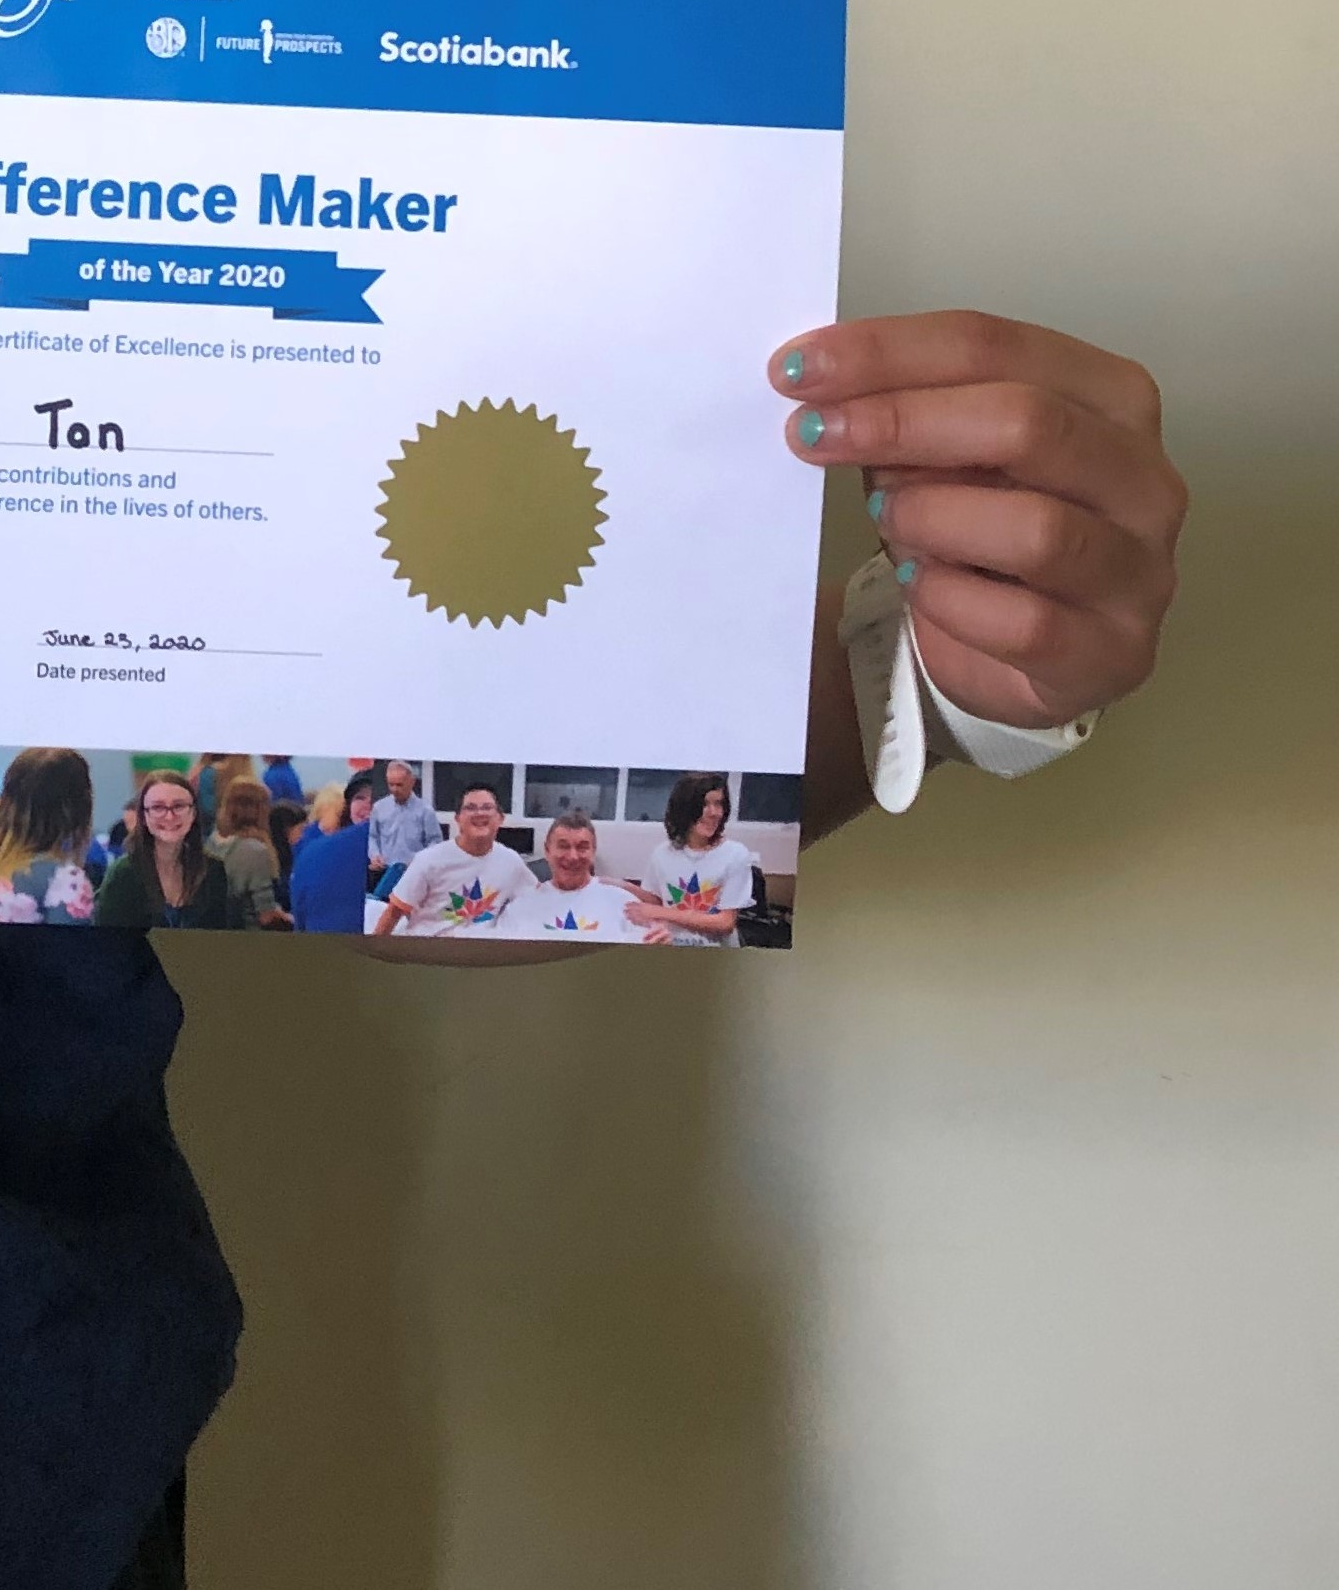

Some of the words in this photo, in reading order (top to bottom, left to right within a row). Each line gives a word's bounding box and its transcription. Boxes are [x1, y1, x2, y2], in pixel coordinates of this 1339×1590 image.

[216, 37, 260, 50] FUTURE
[380, 32, 569, 70] Scotiabank
[259, 172, 457, 234] Maker
[79, 259, 105, 281] of
[111, 262, 151, 283] the
[158, 261, 213, 286] Year
[220, 265, 285, 289] 2020
[88, 332, 110, 353] of
[115, 335, 224, 359] Excellence
[231, 339, 246, 360] is
[252, 341, 355, 367] presented
[360, 345, 381, 365] to
[138, 471, 177, 489] and
[61, 495, 78, 514] in
[85, 496, 117, 515] the
[124, 498, 167, 517] lives
[174, 500, 194, 518] of
[199, 501, 268, 521] others.
[42, 629, 95, 647] June
[149, 633, 206, 651] 2020
[37, 662, 75, 679] Date
[81, 664, 166, 683] presented
